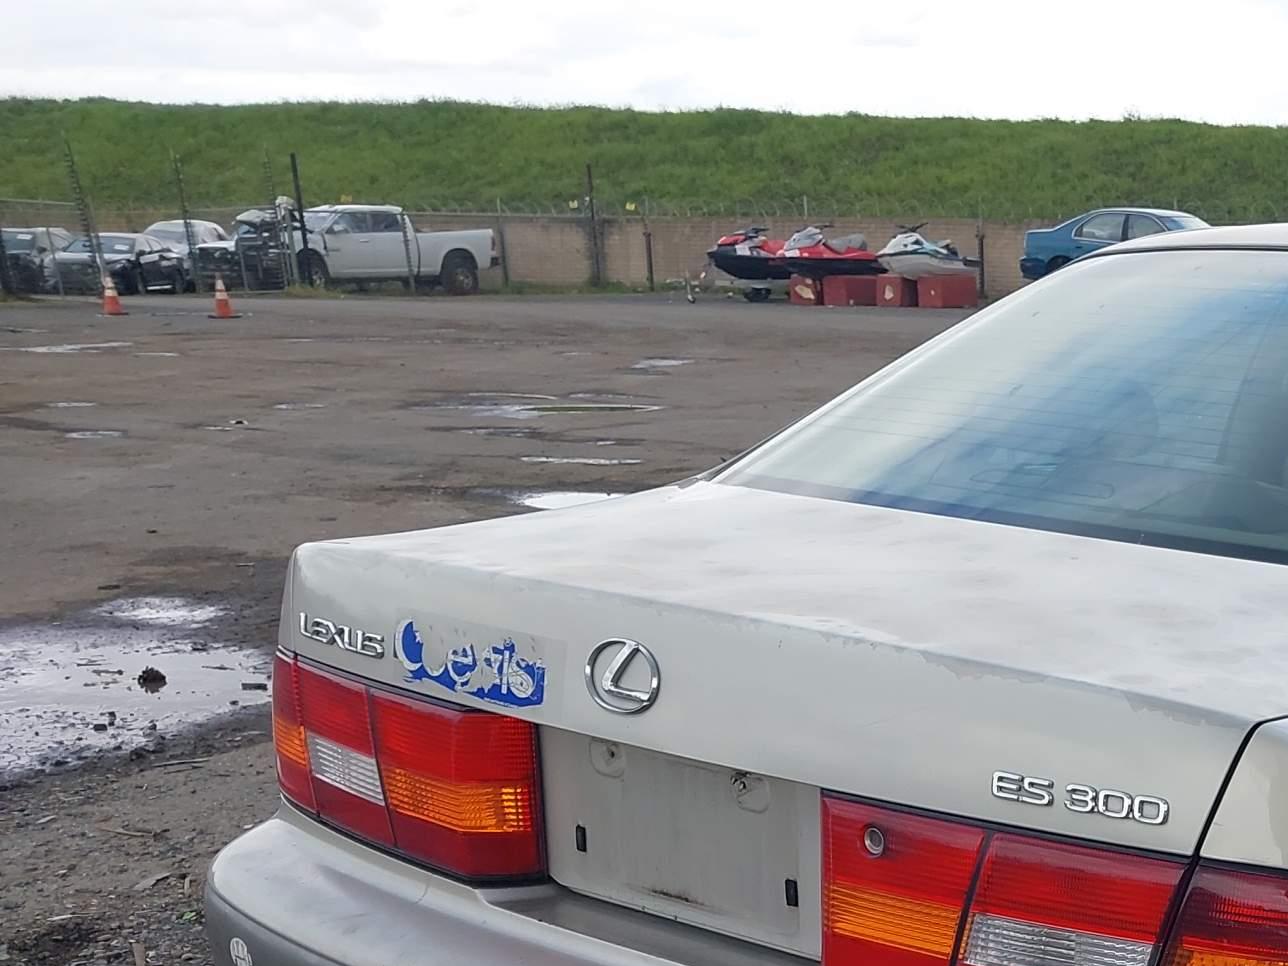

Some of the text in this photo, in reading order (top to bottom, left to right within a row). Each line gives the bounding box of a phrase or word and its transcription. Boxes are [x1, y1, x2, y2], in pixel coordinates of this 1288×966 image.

[299, 611, 385, 659] LEXUS
[991, 770, 1169, 825] ES 300
